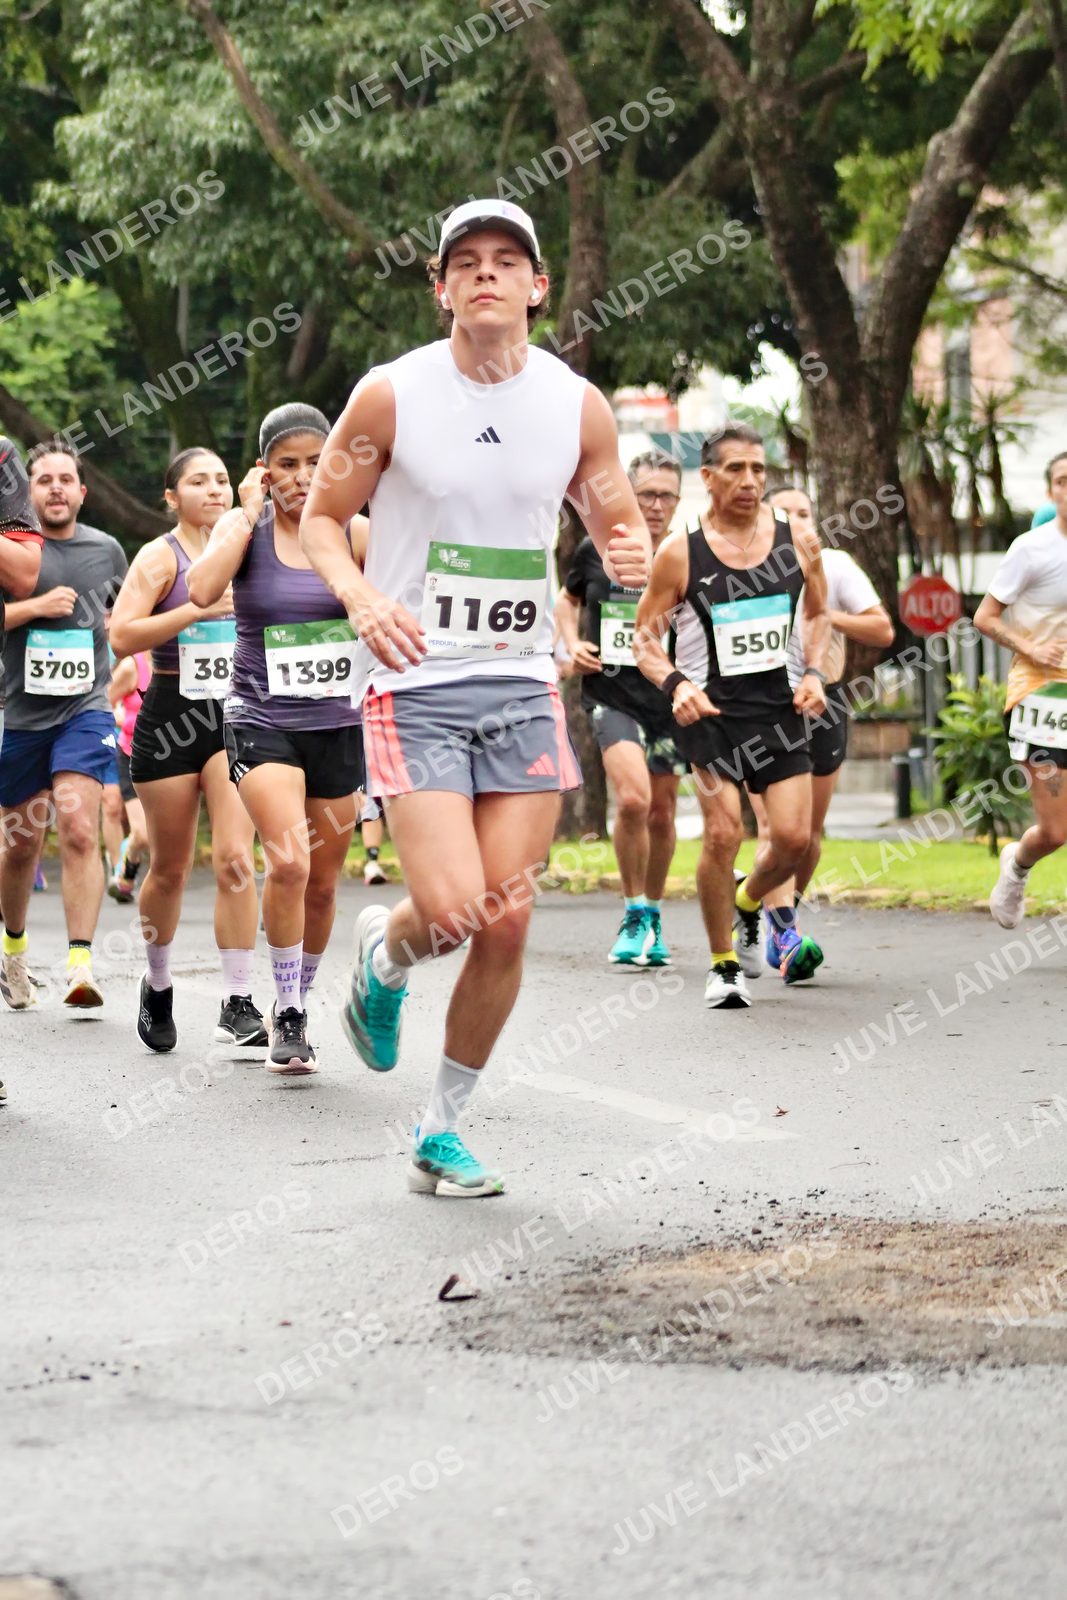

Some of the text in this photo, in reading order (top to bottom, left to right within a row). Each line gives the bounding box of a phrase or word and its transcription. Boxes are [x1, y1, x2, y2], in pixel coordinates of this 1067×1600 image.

[435, 595, 537, 633] 1169
[904, 591, 954, 617] ALTO
[30, 660, 90, 679] 3709
[194, 658, 232, 680] 38
[276, 657, 352, 686] 1399
[273, 960, 300, 969] JUST
